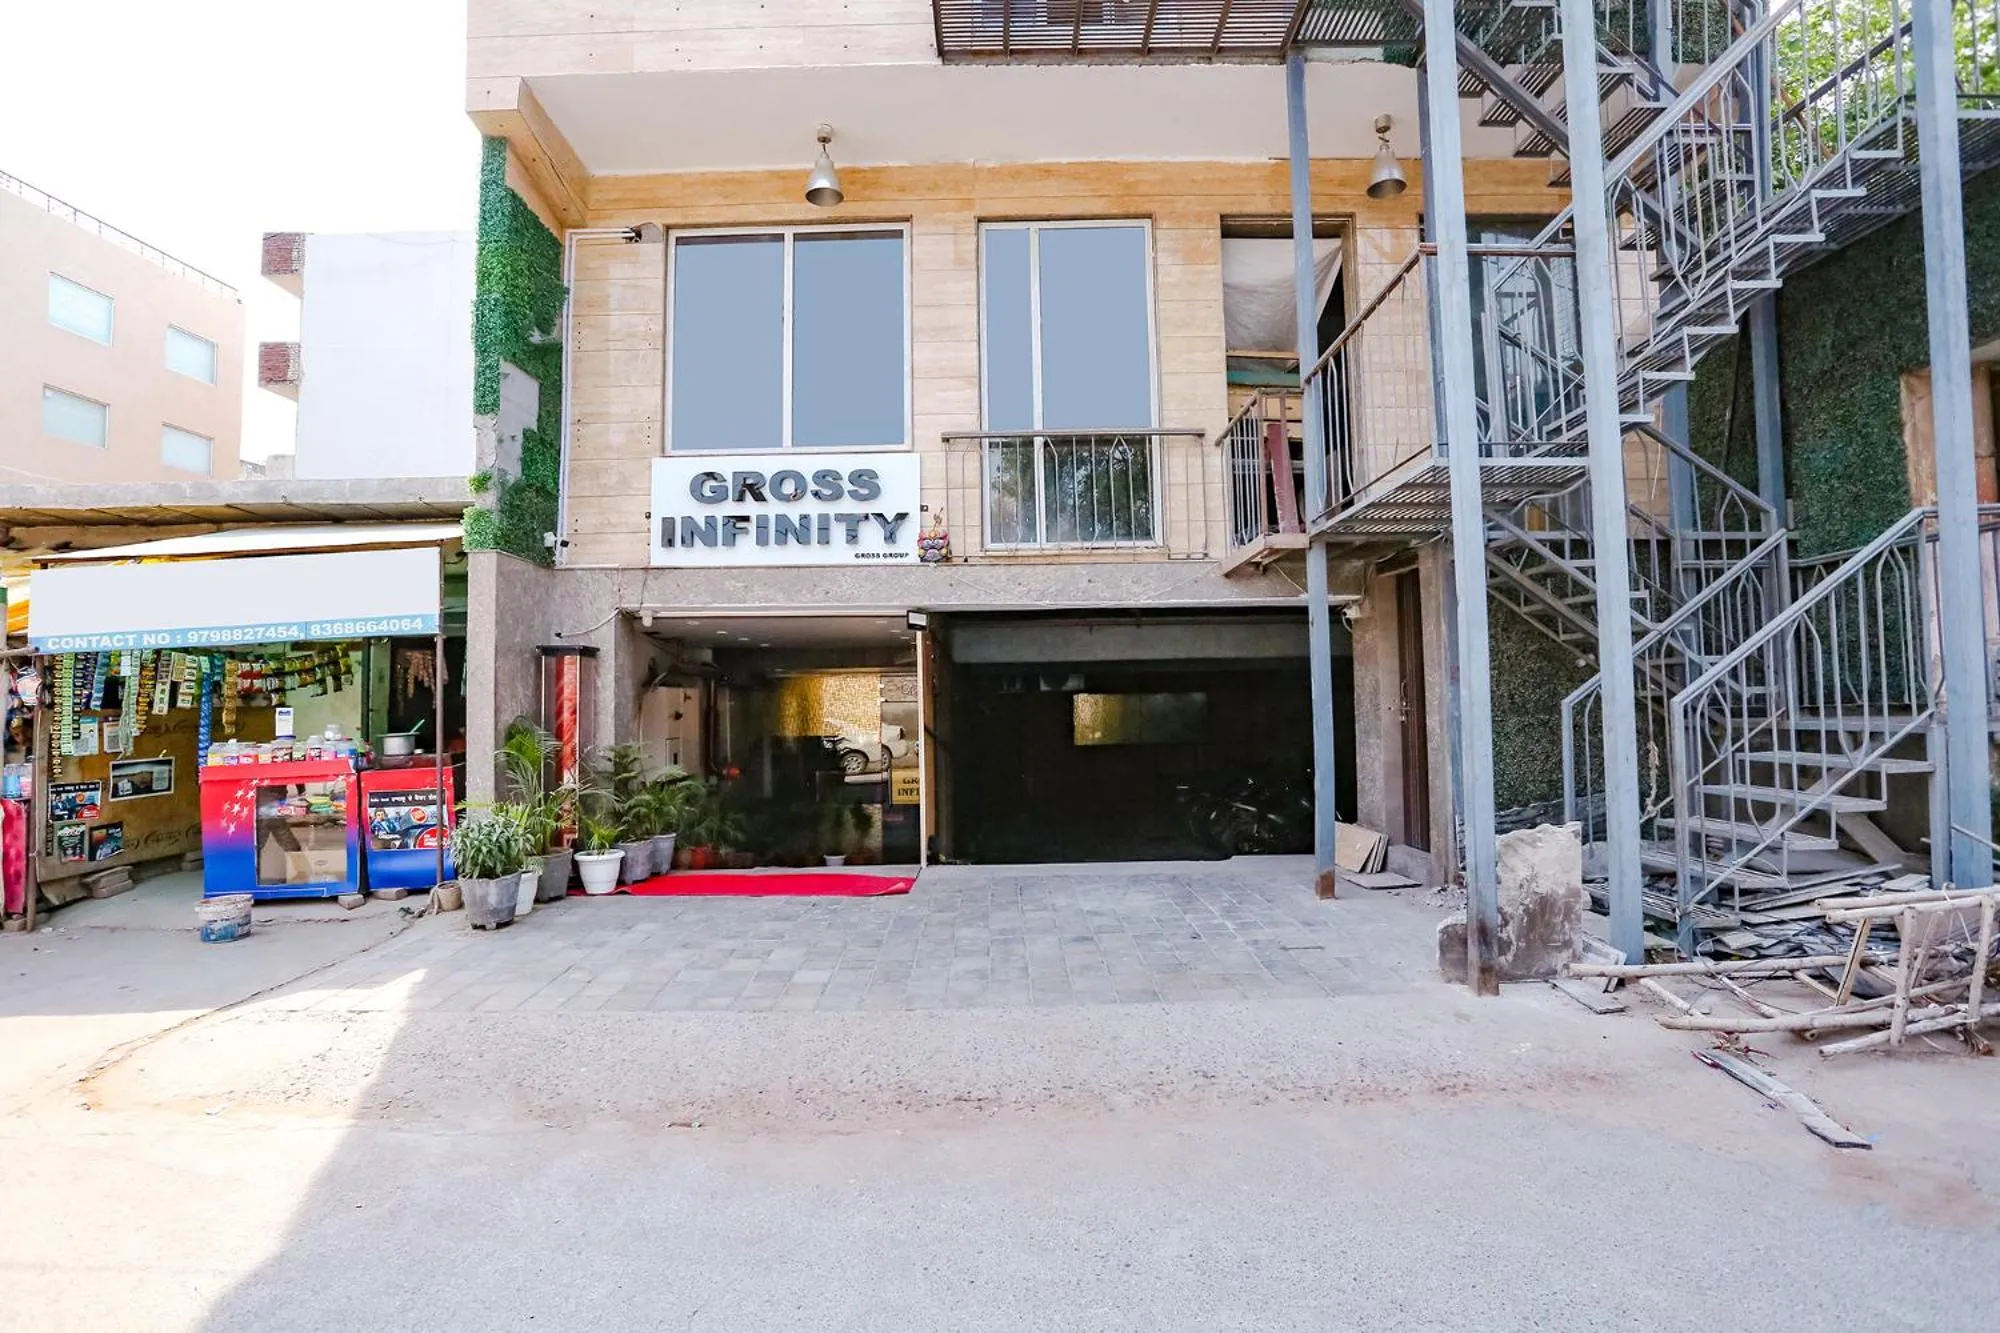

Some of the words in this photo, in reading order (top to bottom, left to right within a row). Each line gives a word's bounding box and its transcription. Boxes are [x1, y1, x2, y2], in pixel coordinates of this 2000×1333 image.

[689, 468, 882, 504] GROSS
[661, 511, 909, 548] INFINITY
[47, 634, 137, 650] CONTACT
[143, 633, 170, 647] NO
[310, 617, 423, 637] 8368664064
[897, 787, 920, 796] INFI
